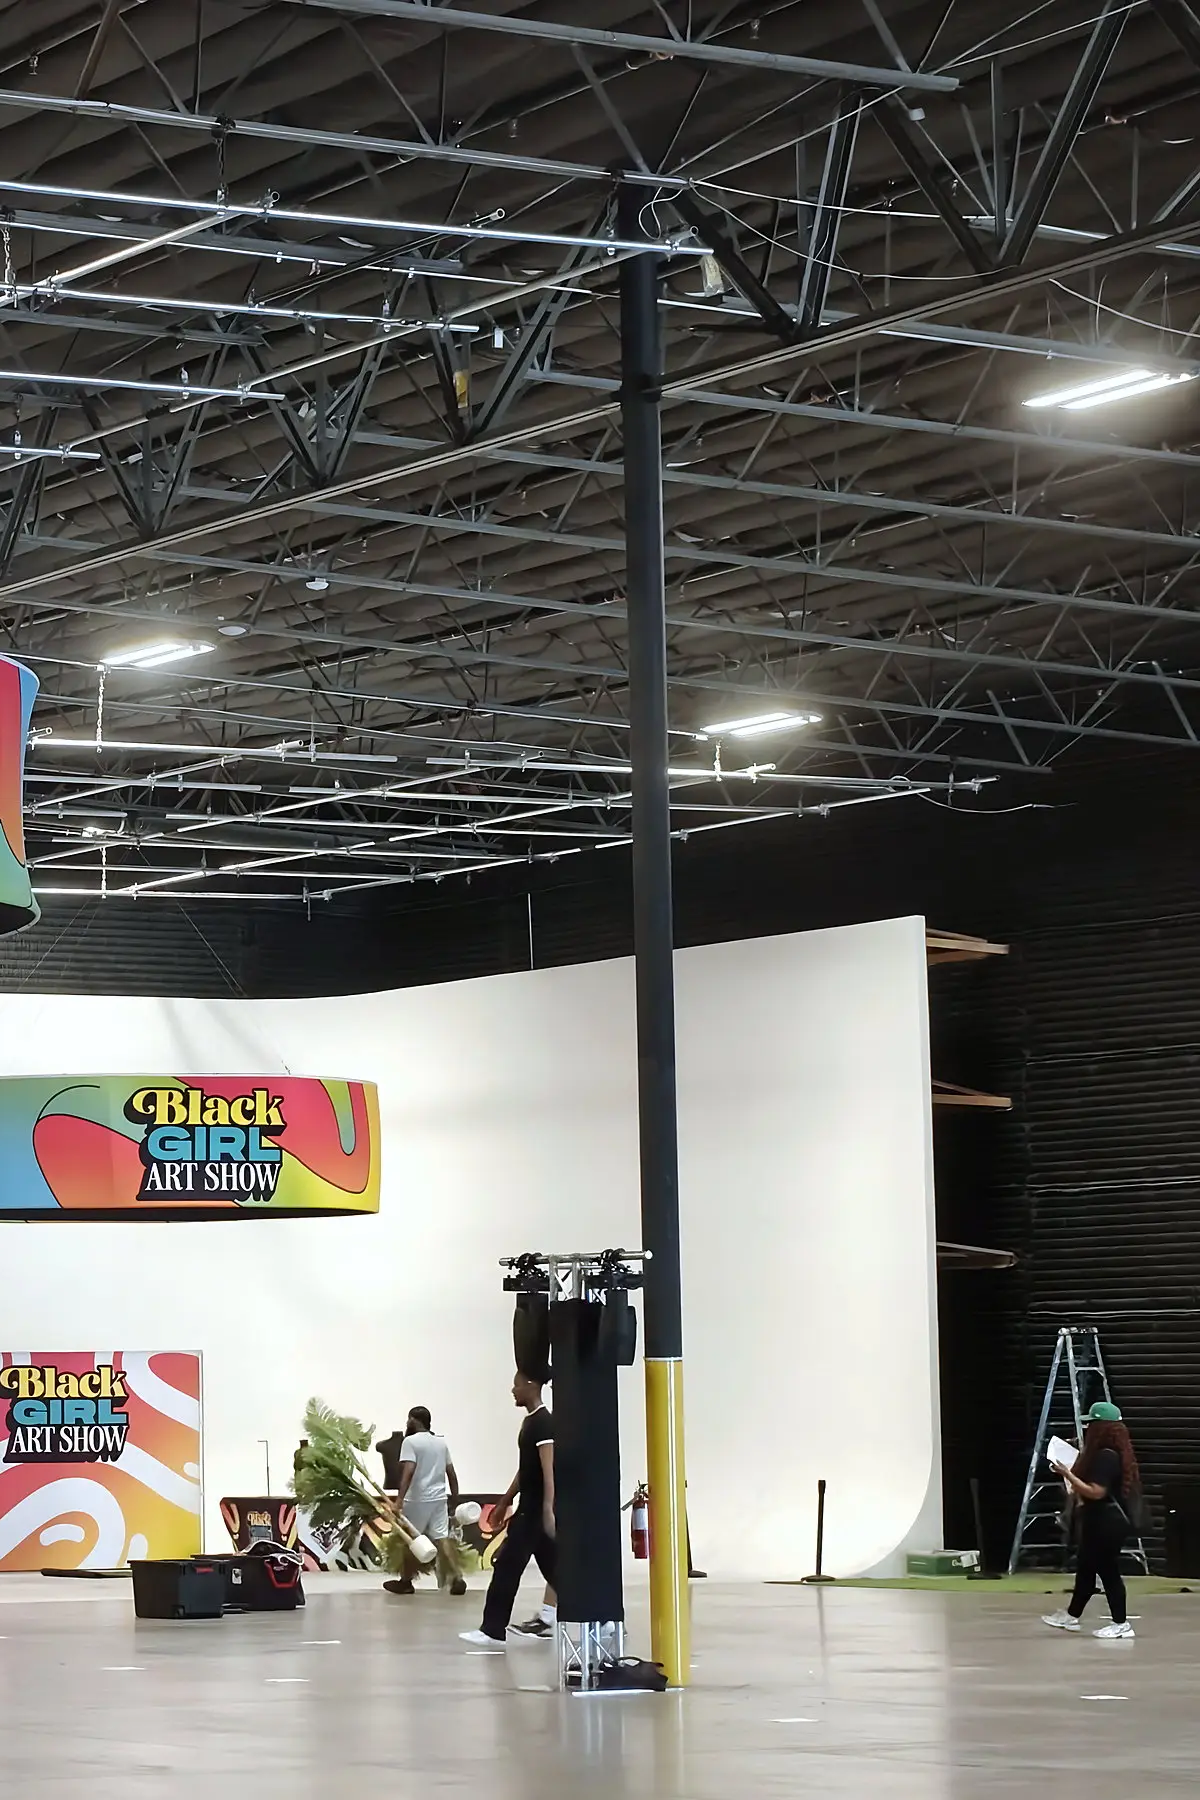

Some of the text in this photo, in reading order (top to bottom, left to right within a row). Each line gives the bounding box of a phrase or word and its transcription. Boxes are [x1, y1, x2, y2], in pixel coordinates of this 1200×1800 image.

[132, 1089, 285, 1126] Black
[147, 1126, 281, 1162] GIRL
[145, 1162, 281, 1192] ART SHOW
[0, 1366, 129, 1398] Black
[12, 1399, 128, 1425] GIRL
[10, 1425, 129, 1453] ART SHOW
